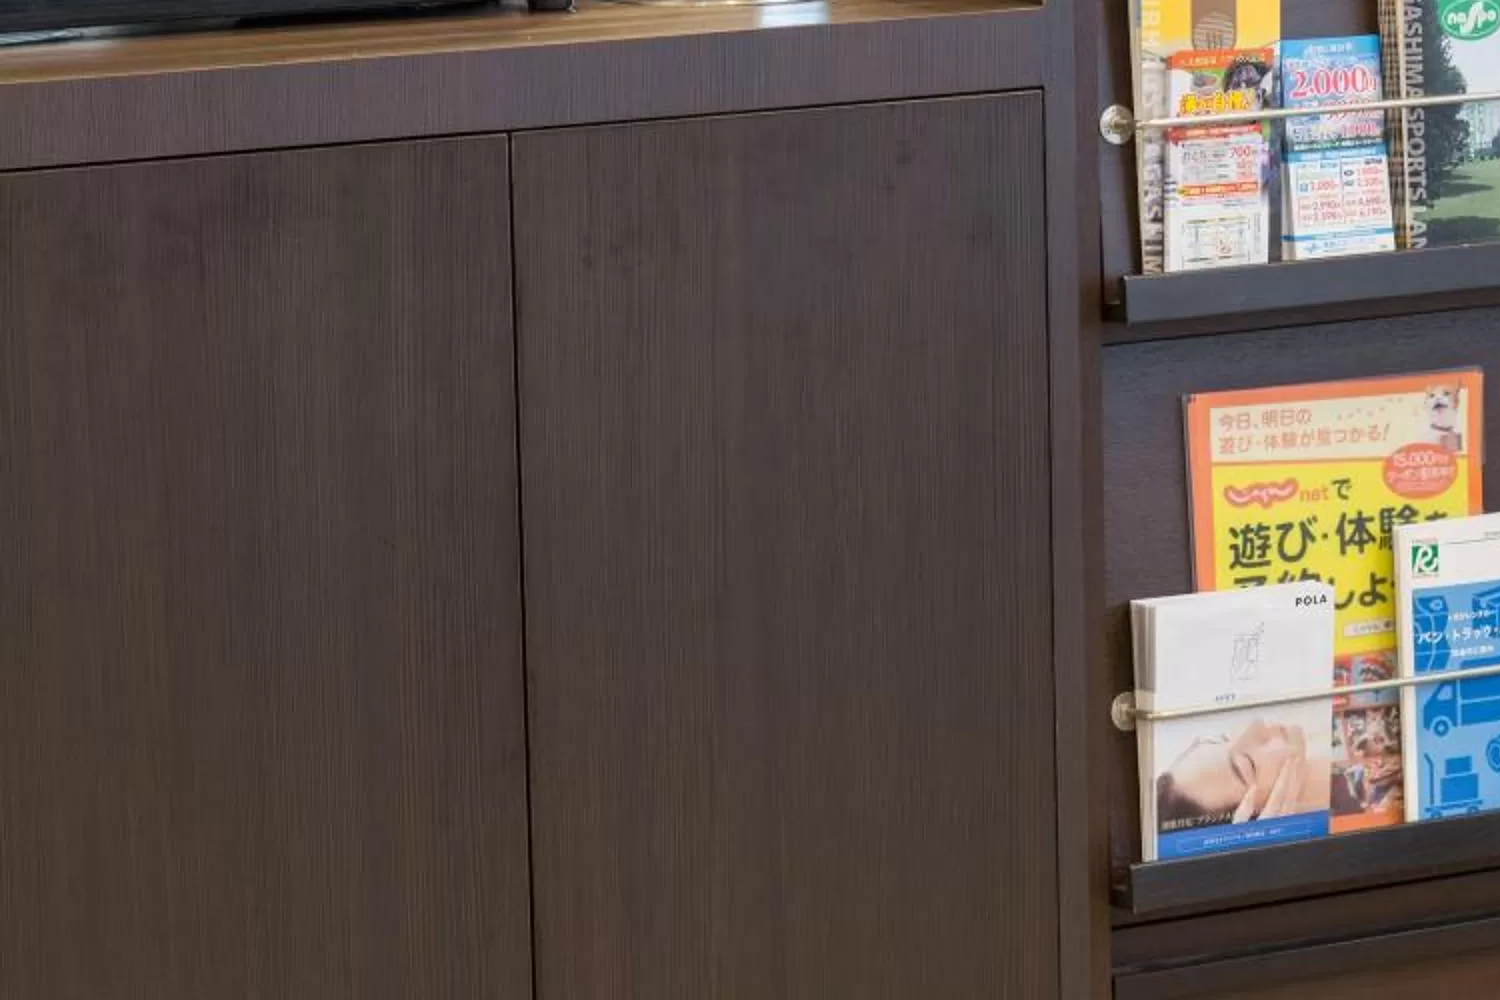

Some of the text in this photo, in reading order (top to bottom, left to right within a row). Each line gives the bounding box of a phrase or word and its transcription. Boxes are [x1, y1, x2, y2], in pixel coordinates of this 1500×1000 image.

[1218, 407, 1313, 431] 今日、明日の
[1228, 503, 1448, 570] 遊び・体験
[1295, 592, 1328, 608] POLA
